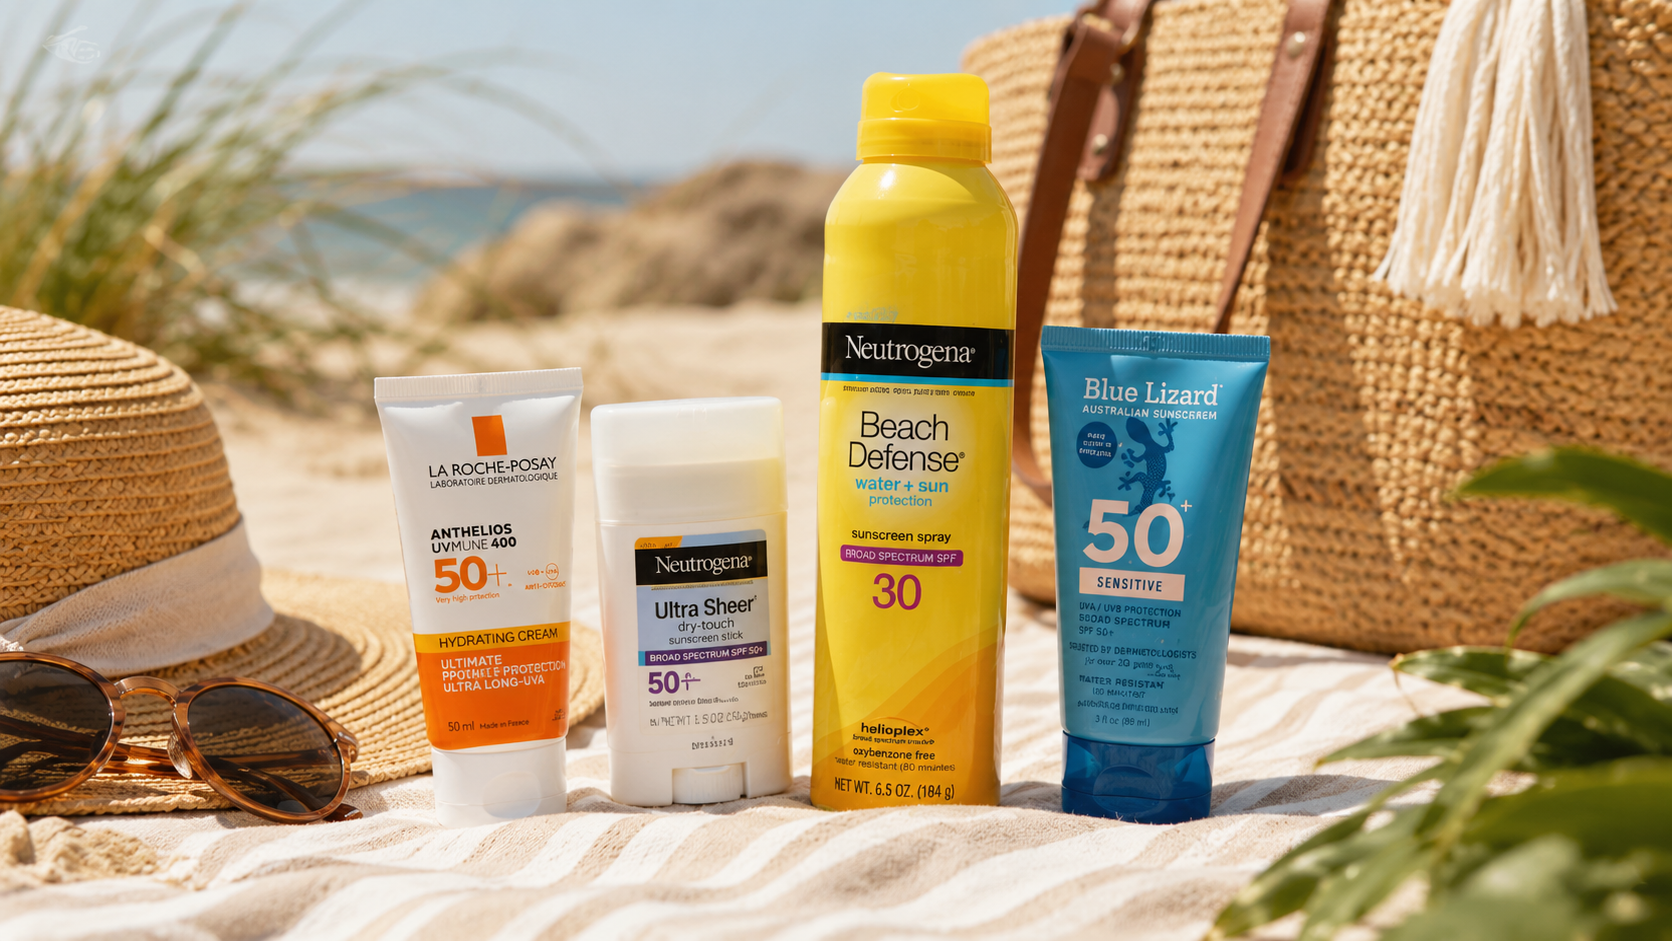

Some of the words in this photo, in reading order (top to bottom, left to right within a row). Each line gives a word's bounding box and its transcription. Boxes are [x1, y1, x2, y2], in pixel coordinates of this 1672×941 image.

[1083, 377, 1138, 403] Blue
[1144, 381, 1223, 406] Lizard
[1082, 405, 1149, 419] AUSTRALIAN
[861, 411, 949, 441] Beach
[429, 464, 448, 478] LA
[452, 457, 557, 476] ROCHE-POSAY
[430, 477, 486, 488] LABORATOIRE
[487, 472, 558, 485] DERMATOLOGIQUE
[855, 477, 901, 492] water
[918, 481, 949, 493] sun
[869, 494, 932, 507] protection
[430, 523, 512, 540] ANTHELIOS
[852, 530, 913, 541] sunscreen
[917, 532, 951, 544] spray
[432, 539, 488, 553] UVMUNE
[490, 537, 517, 549] 400
[845, 549, 876, 560] BROAD
[879, 552, 934, 563] SPECTRUM
[937, 553, 957, 563] SPF
[434, 556, 507, 593] 50+
[872, 573, 922, 610] 30
[1097, 576, 1163, 593] SENSITIVE
[436, 596, 450, 604] Very
[1079, 602, 1096, 611] UVA
[655, 601, 698, 619] Ultra
[678, 617, 734, 633] dry-touch
[1079, 626, 1093, 635] SPF
[439, 633, 515, 648] HYDRATING
[517, 628, 558, 642] CREAM
[668, 634, 719, 645] sunscreen
[721, 631, 743, 641] stick
[441, 655, 502, 669] ULTIMATE
[649, 652, 681, 663] BROAD
[682, 649, 730, 661] SPECTRUM
[731, 647, 747, 657] SPF
[443, 681, 482, 693] ULTRA
[485, 674, 545, 690] LONG-UVA
[448, 721, 460, 732] 50
[462, 721, 475, 731] ml
[1095, 715, 1100, 723] 3
[853, 747, 912, 760] oxybenzone
[915, 750, 935, 760] free
[858, 760, 897, 771] resistant
[900, 763, 915, 773] (80
[835, 777, 852, 792] NET
[854, 781, 872, 795] WT.
[875, 783, 892, 796] 6.5
[895, 783, 914, 798] OZ.
[917, 784, 942, 800] (184
[944, 784, 955, 801] g)
